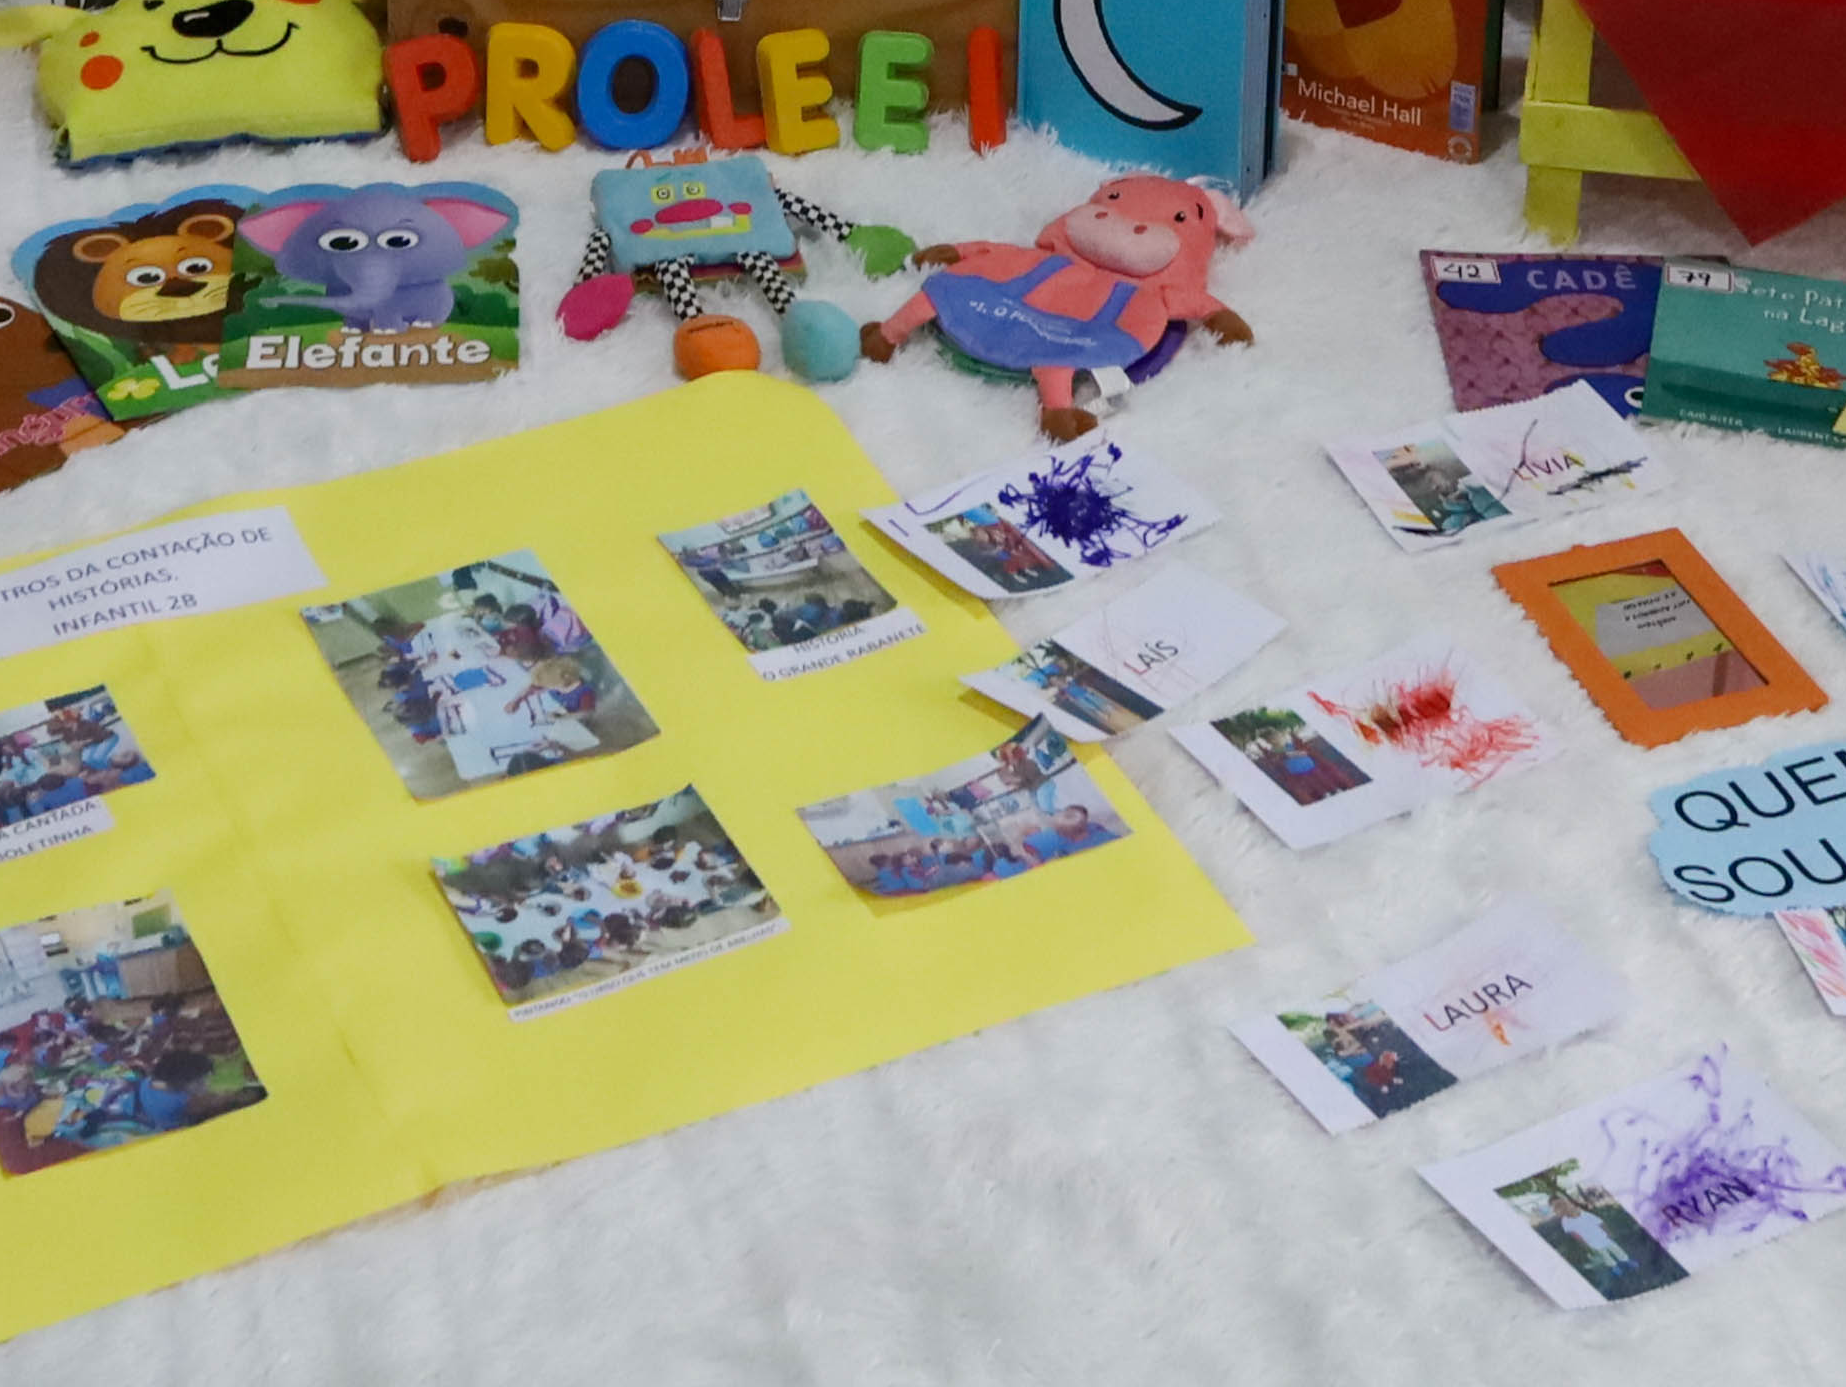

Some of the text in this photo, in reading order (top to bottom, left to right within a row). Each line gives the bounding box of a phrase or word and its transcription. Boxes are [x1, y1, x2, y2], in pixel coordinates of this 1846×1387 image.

[1297, 76, 1422, 127] Michael Hall
[1445, 262, 1481, 280] 42
[1526, 264, 1638, 291] CADÊ
[1676, 268, 1713, 286] 79
[1734, 275, 1796, 303] Sete
[1763, 307, 1788, 322] na
[244, 332, 491, 371] Elefante
[67, 560, 101, 583] DA
[106, 528, 235, 572] CONTAÇÃO
[241, 527, 273, 544] DE
[52, 593, 198, 637] INFANTIL 2B
[1123, 638, 1179, 677] LAÍS
[1423, 972, 1534, 1034] LAURA
[1662, 1174, 1757, 1227] RYAN
